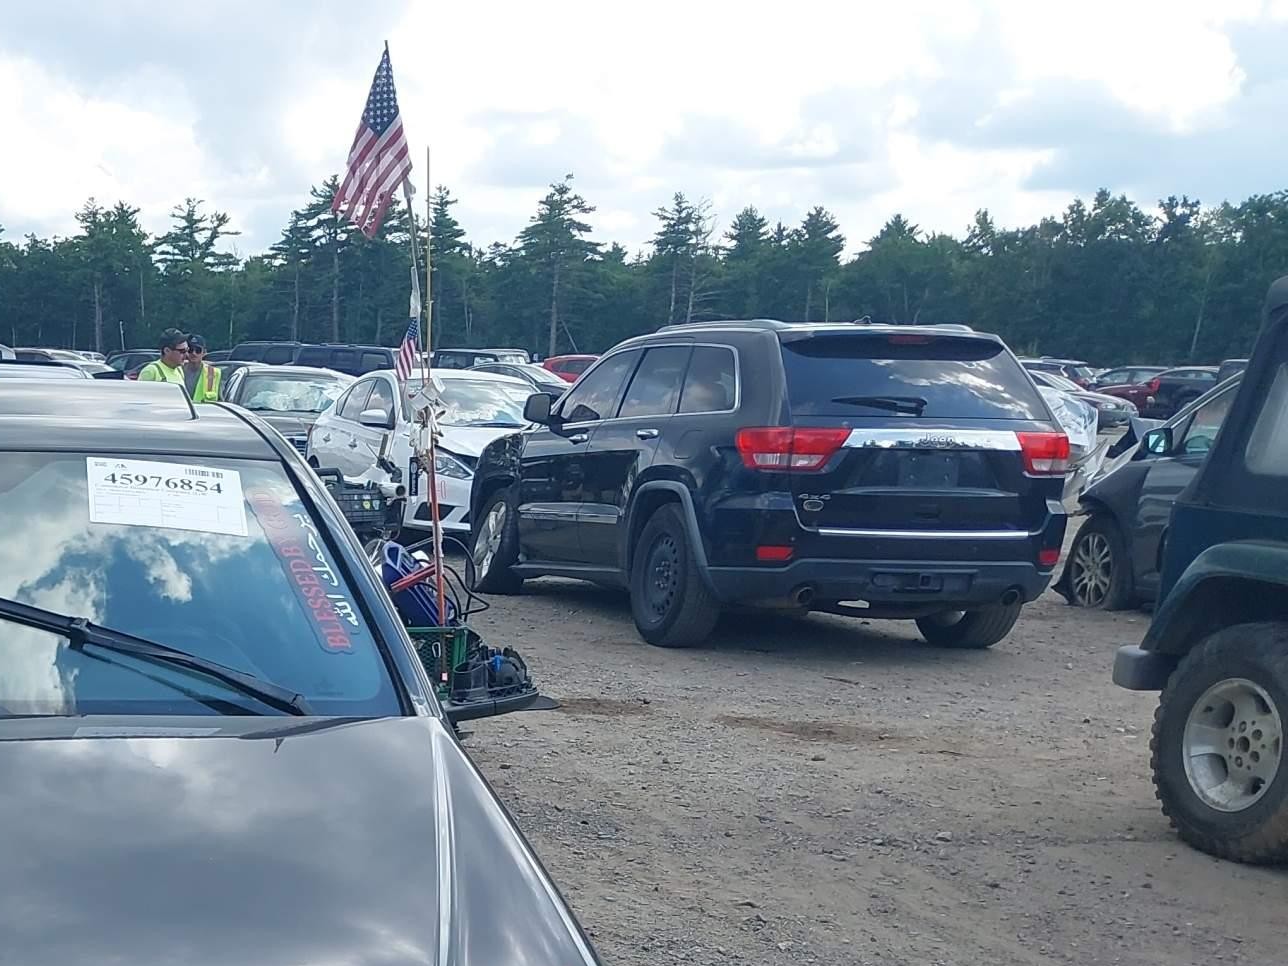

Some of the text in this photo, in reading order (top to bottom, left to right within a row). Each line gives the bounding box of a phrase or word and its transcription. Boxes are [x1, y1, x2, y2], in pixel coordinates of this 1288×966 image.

[919, 431, 953, 449] Jeep
[104, 472, 223, 494] 45976854
[278, 536, 304, 558] BY
[290, 559, 351, 648] BLESSED
